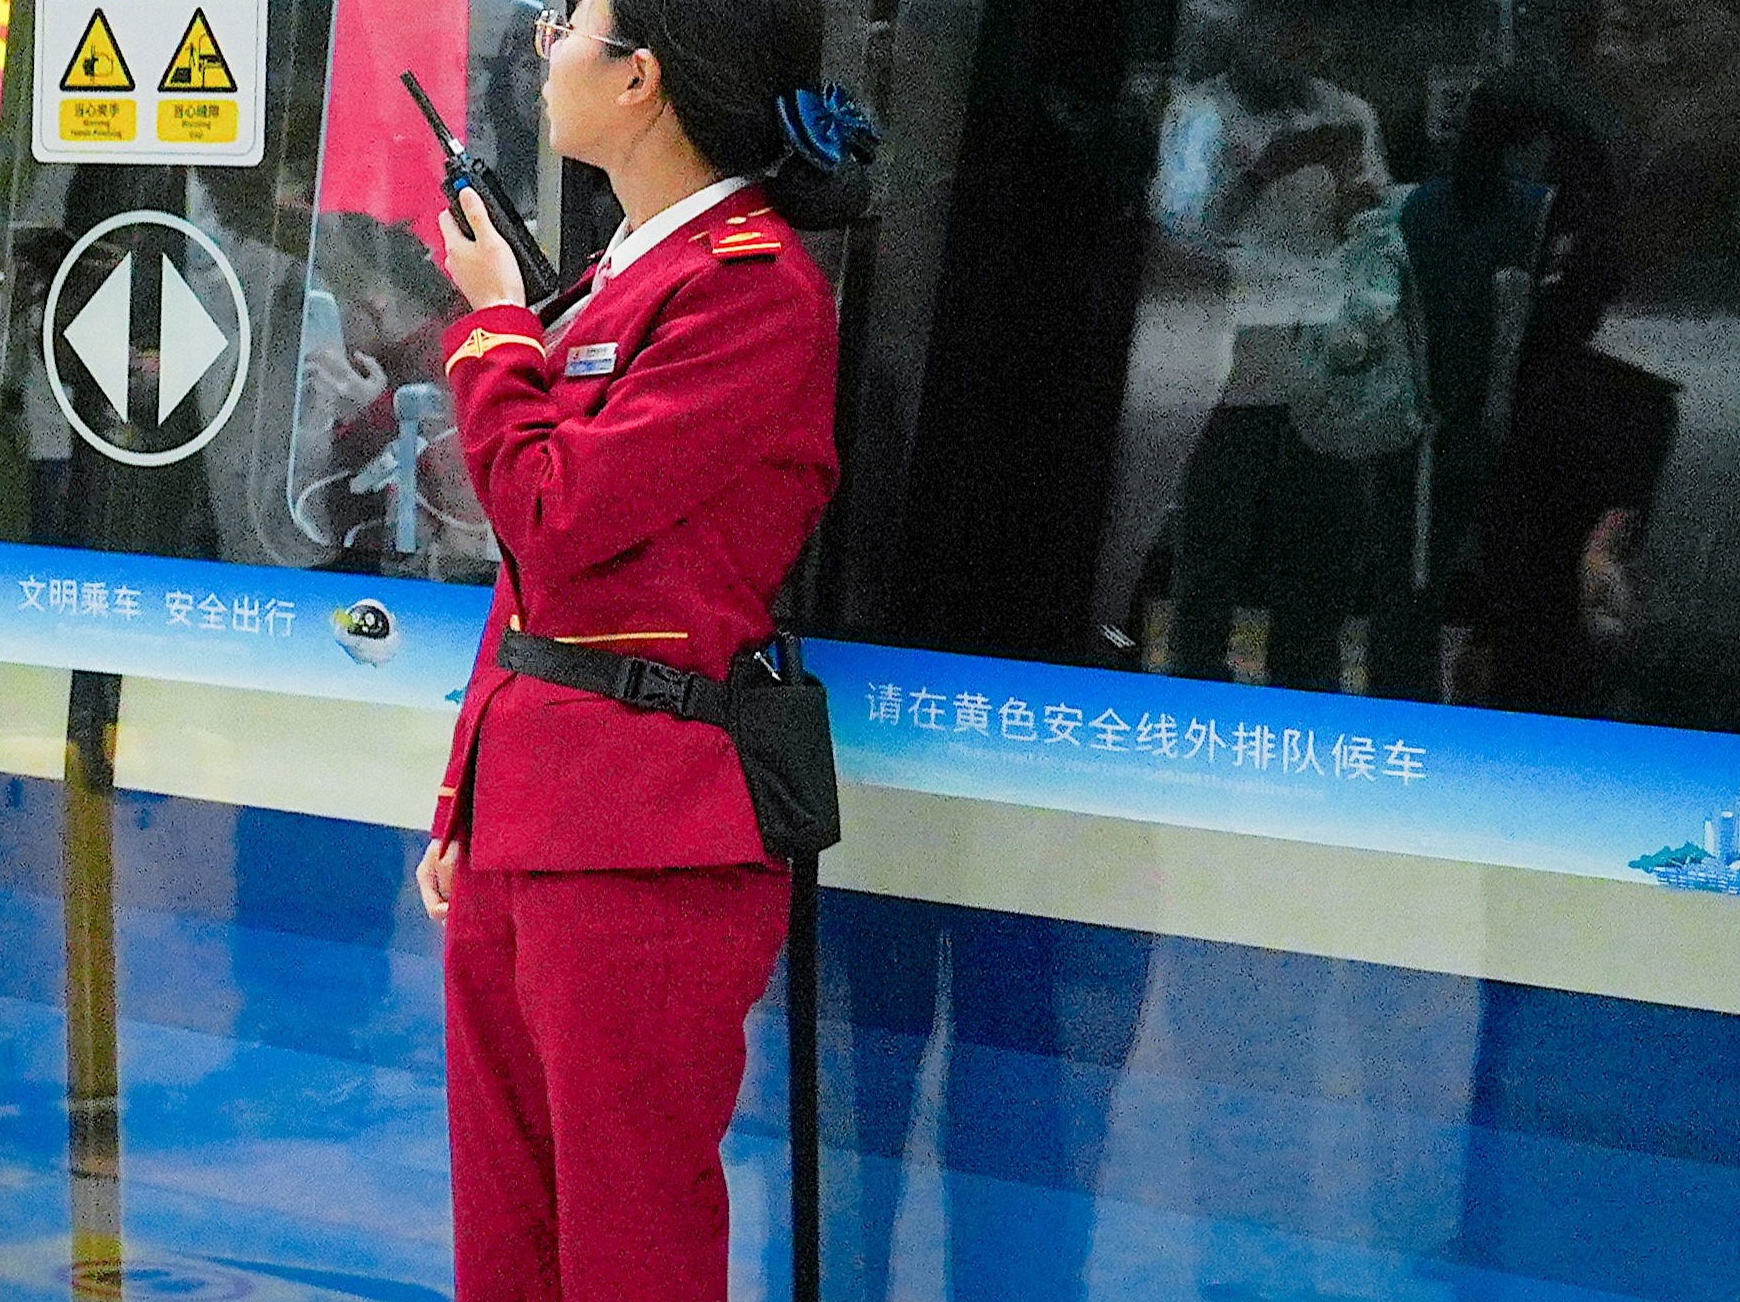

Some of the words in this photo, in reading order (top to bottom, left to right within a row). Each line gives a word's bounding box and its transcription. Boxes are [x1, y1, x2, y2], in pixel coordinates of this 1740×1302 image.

[17, 573, 143, 619] 文明乘车
[166, 590, 297, 639] 安全出行
[865, 681, 1429, 787] 请在黄色安全线外排队候车
